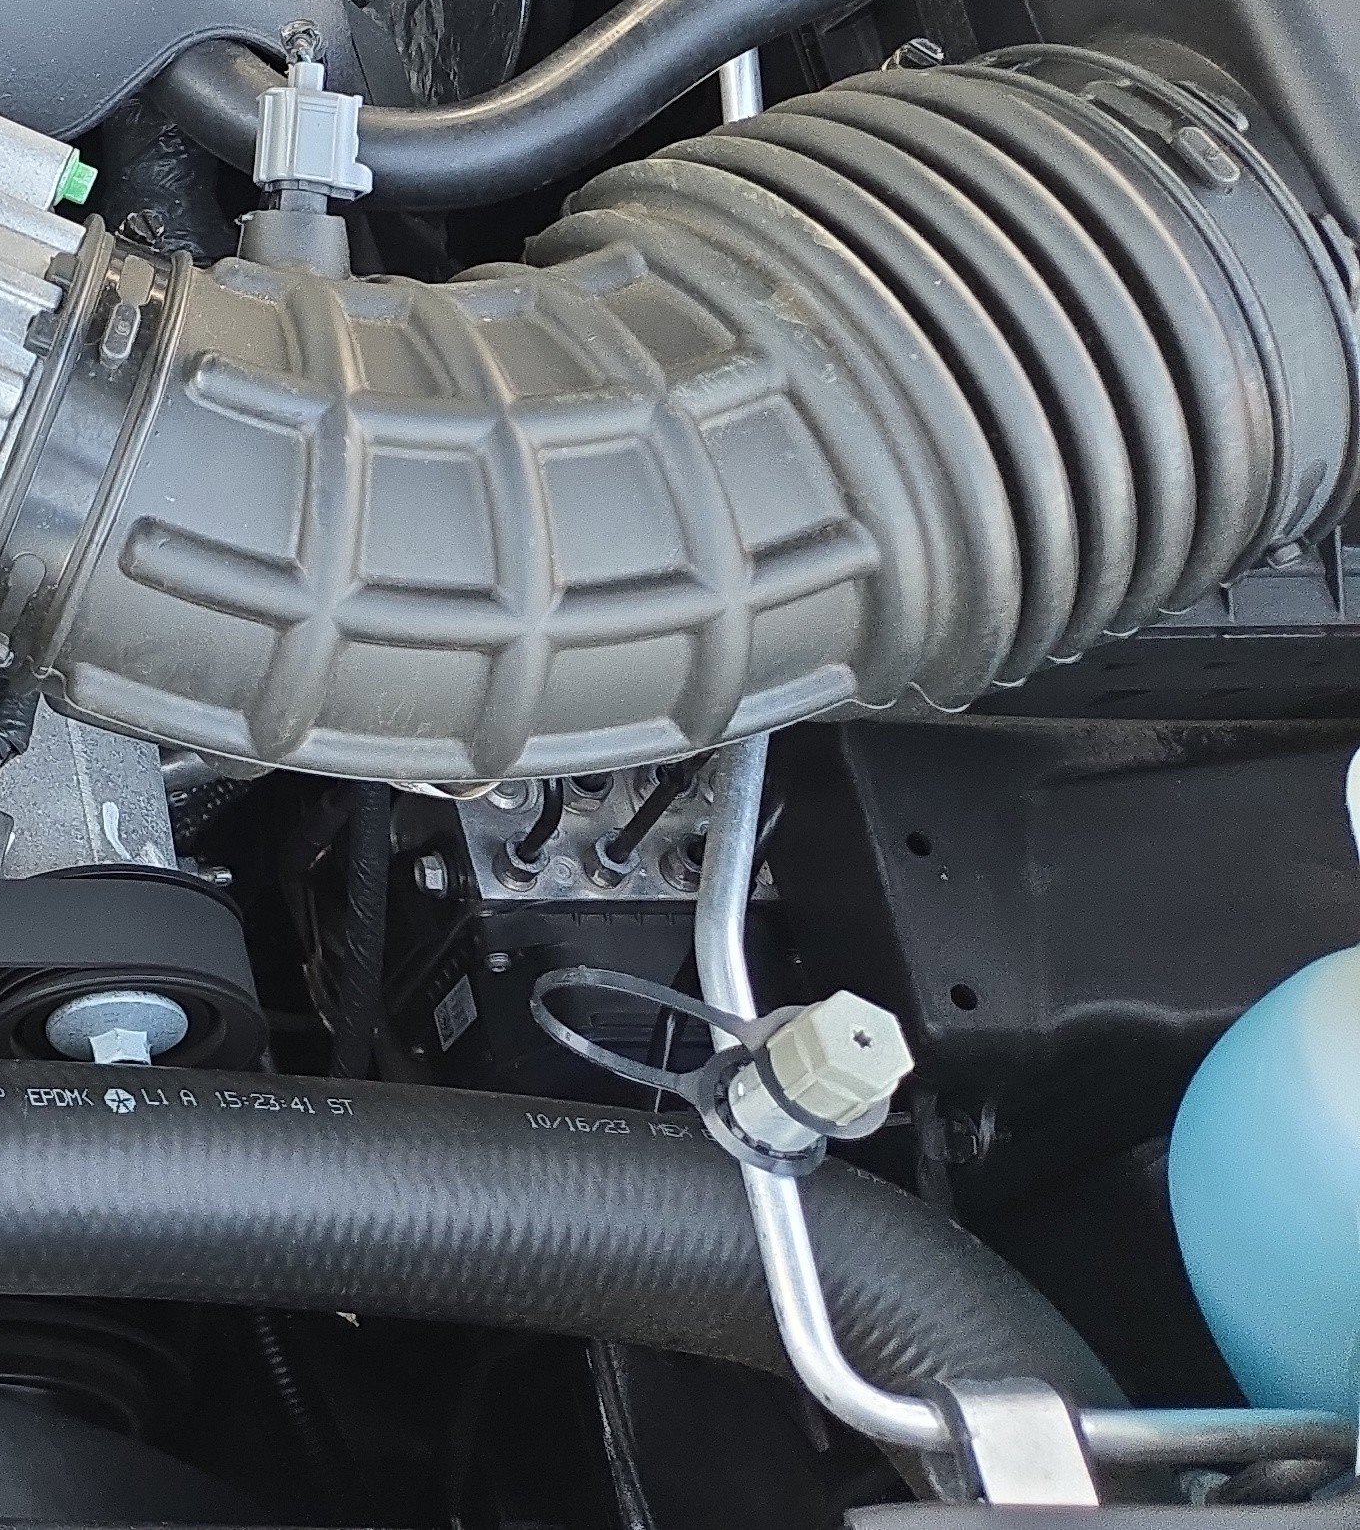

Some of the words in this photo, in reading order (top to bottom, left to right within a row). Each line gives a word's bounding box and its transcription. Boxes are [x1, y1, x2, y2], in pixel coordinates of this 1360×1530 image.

[179, 1088, 201, 1108] A
[213, 1091, 317, 1114] 15:23:41
[328, 1097, 354, 1118] ST
[524, 1111, 631, 1136] 10/16/23
